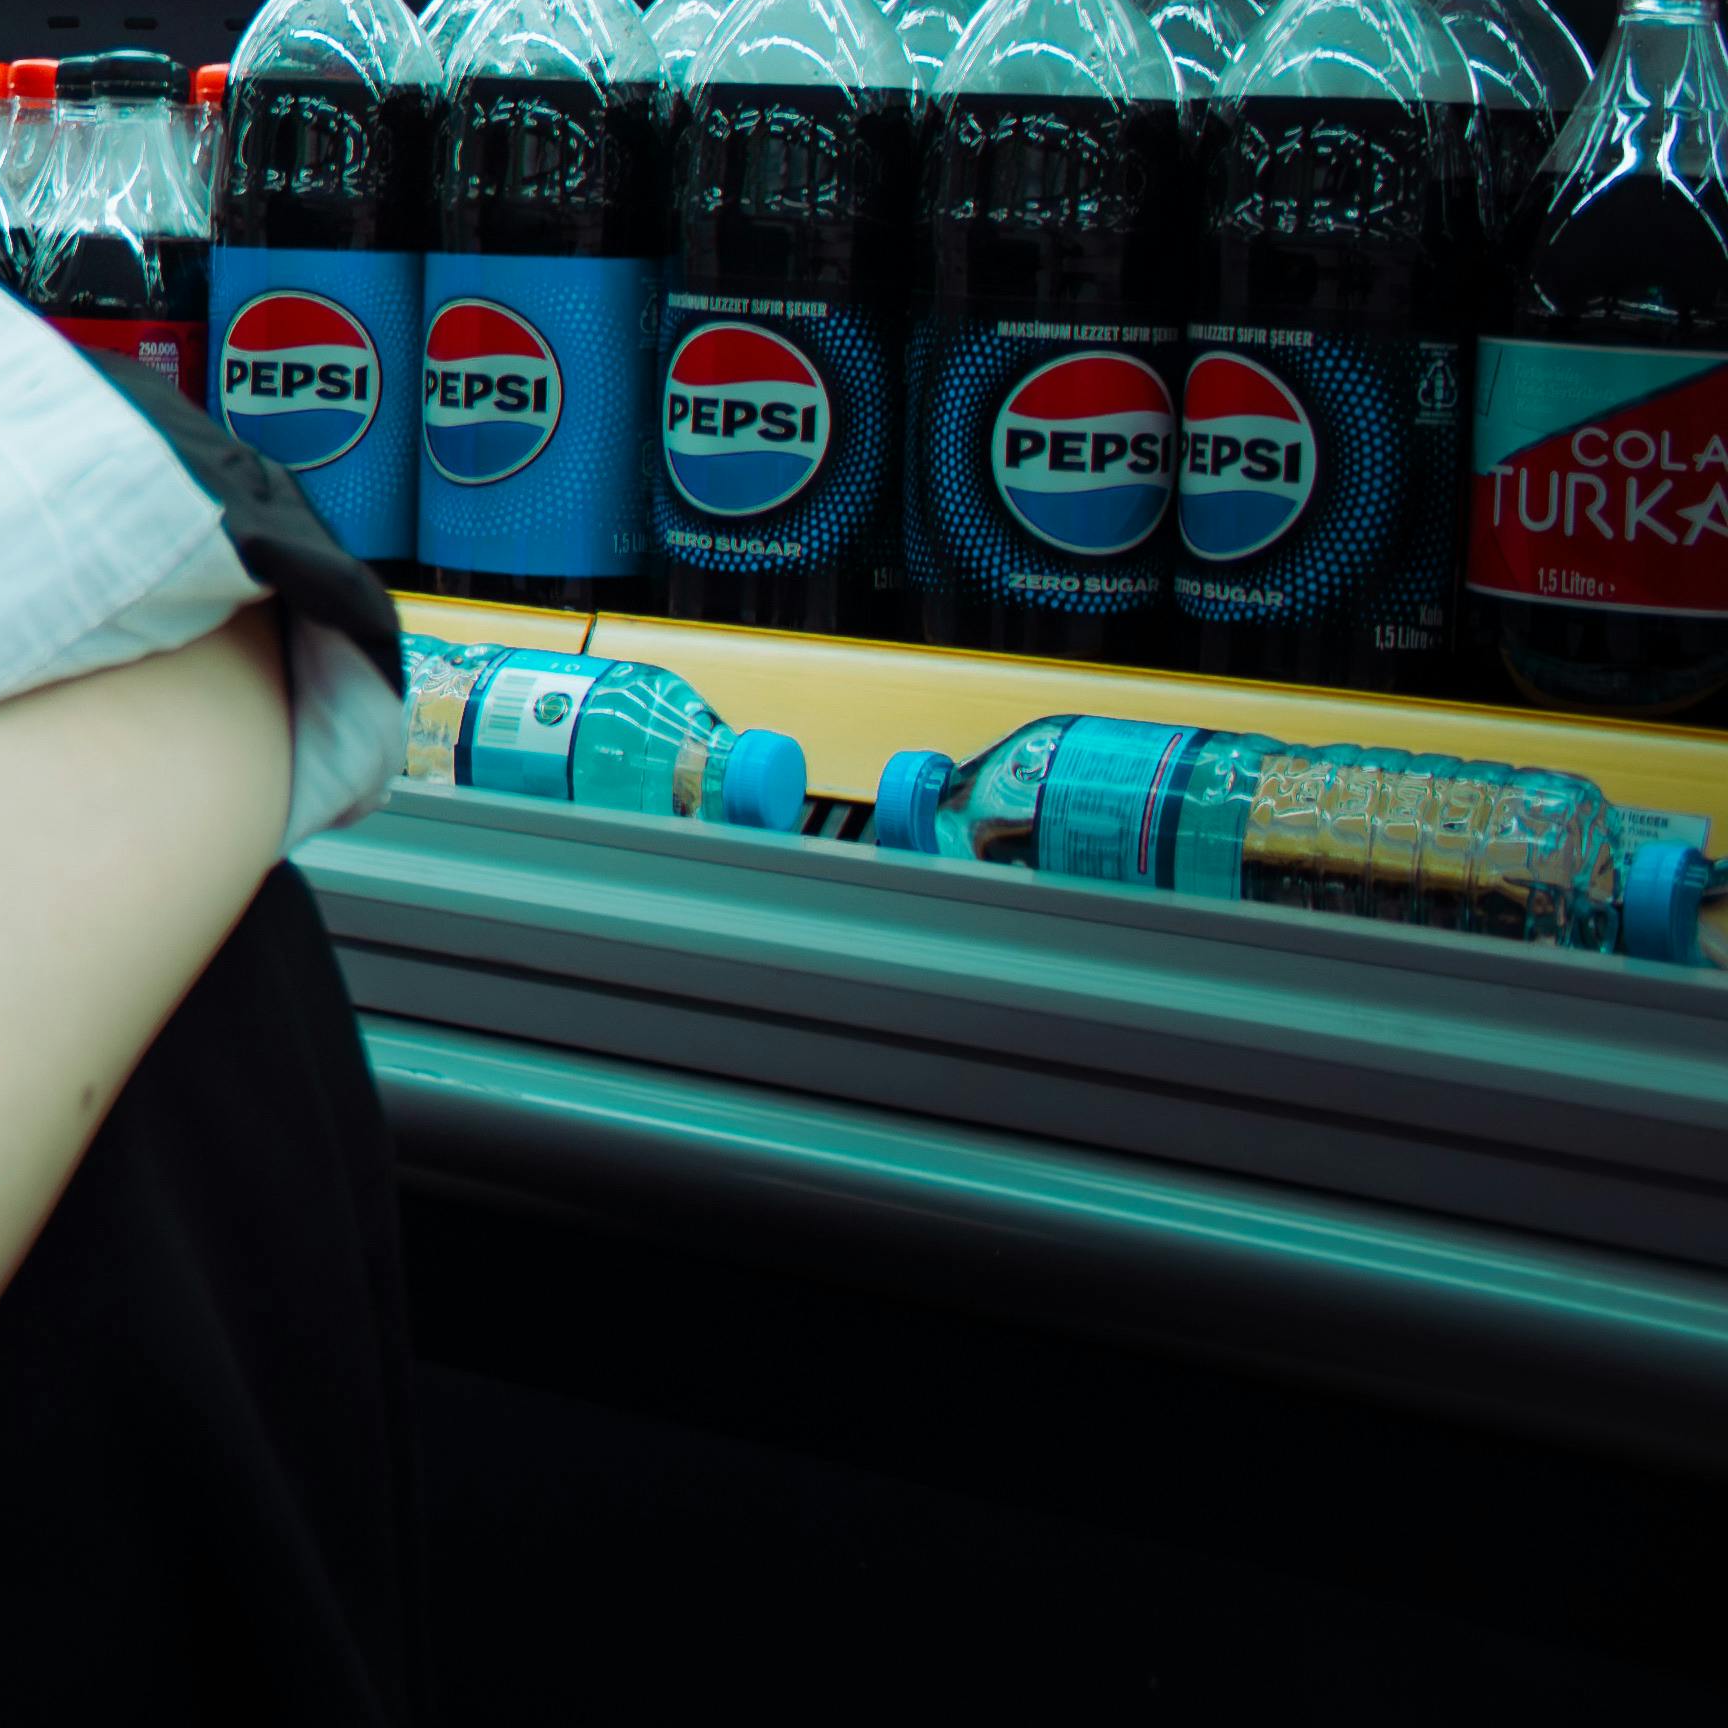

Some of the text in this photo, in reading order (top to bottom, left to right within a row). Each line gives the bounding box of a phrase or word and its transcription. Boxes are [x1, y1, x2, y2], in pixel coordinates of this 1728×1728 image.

[997, 319, 1072, 341] MAKSİMUM
[1073, 323, 1121, 342] LEZZET
[1122, 326, 1152, 342] SIFIR
[1269, 329, 1314, 350] ŞEKER
[225, 357, 370, 401] PEPSI
[423, 368, 548, 414] PEPSI
[668, 393, 818, 444] PEPSI
[1005, 427, 1173, 475] PEPSI
[714, 535, 802, 558] SUGAR
[1008, 572, 1161, 594] ZERO SUGAR
[1202, 580, 1284, 608] SUGAR
[1537, 566, 1597, 598] 1,5 Litre
[1374, 623, 1396, 652] 1,5
